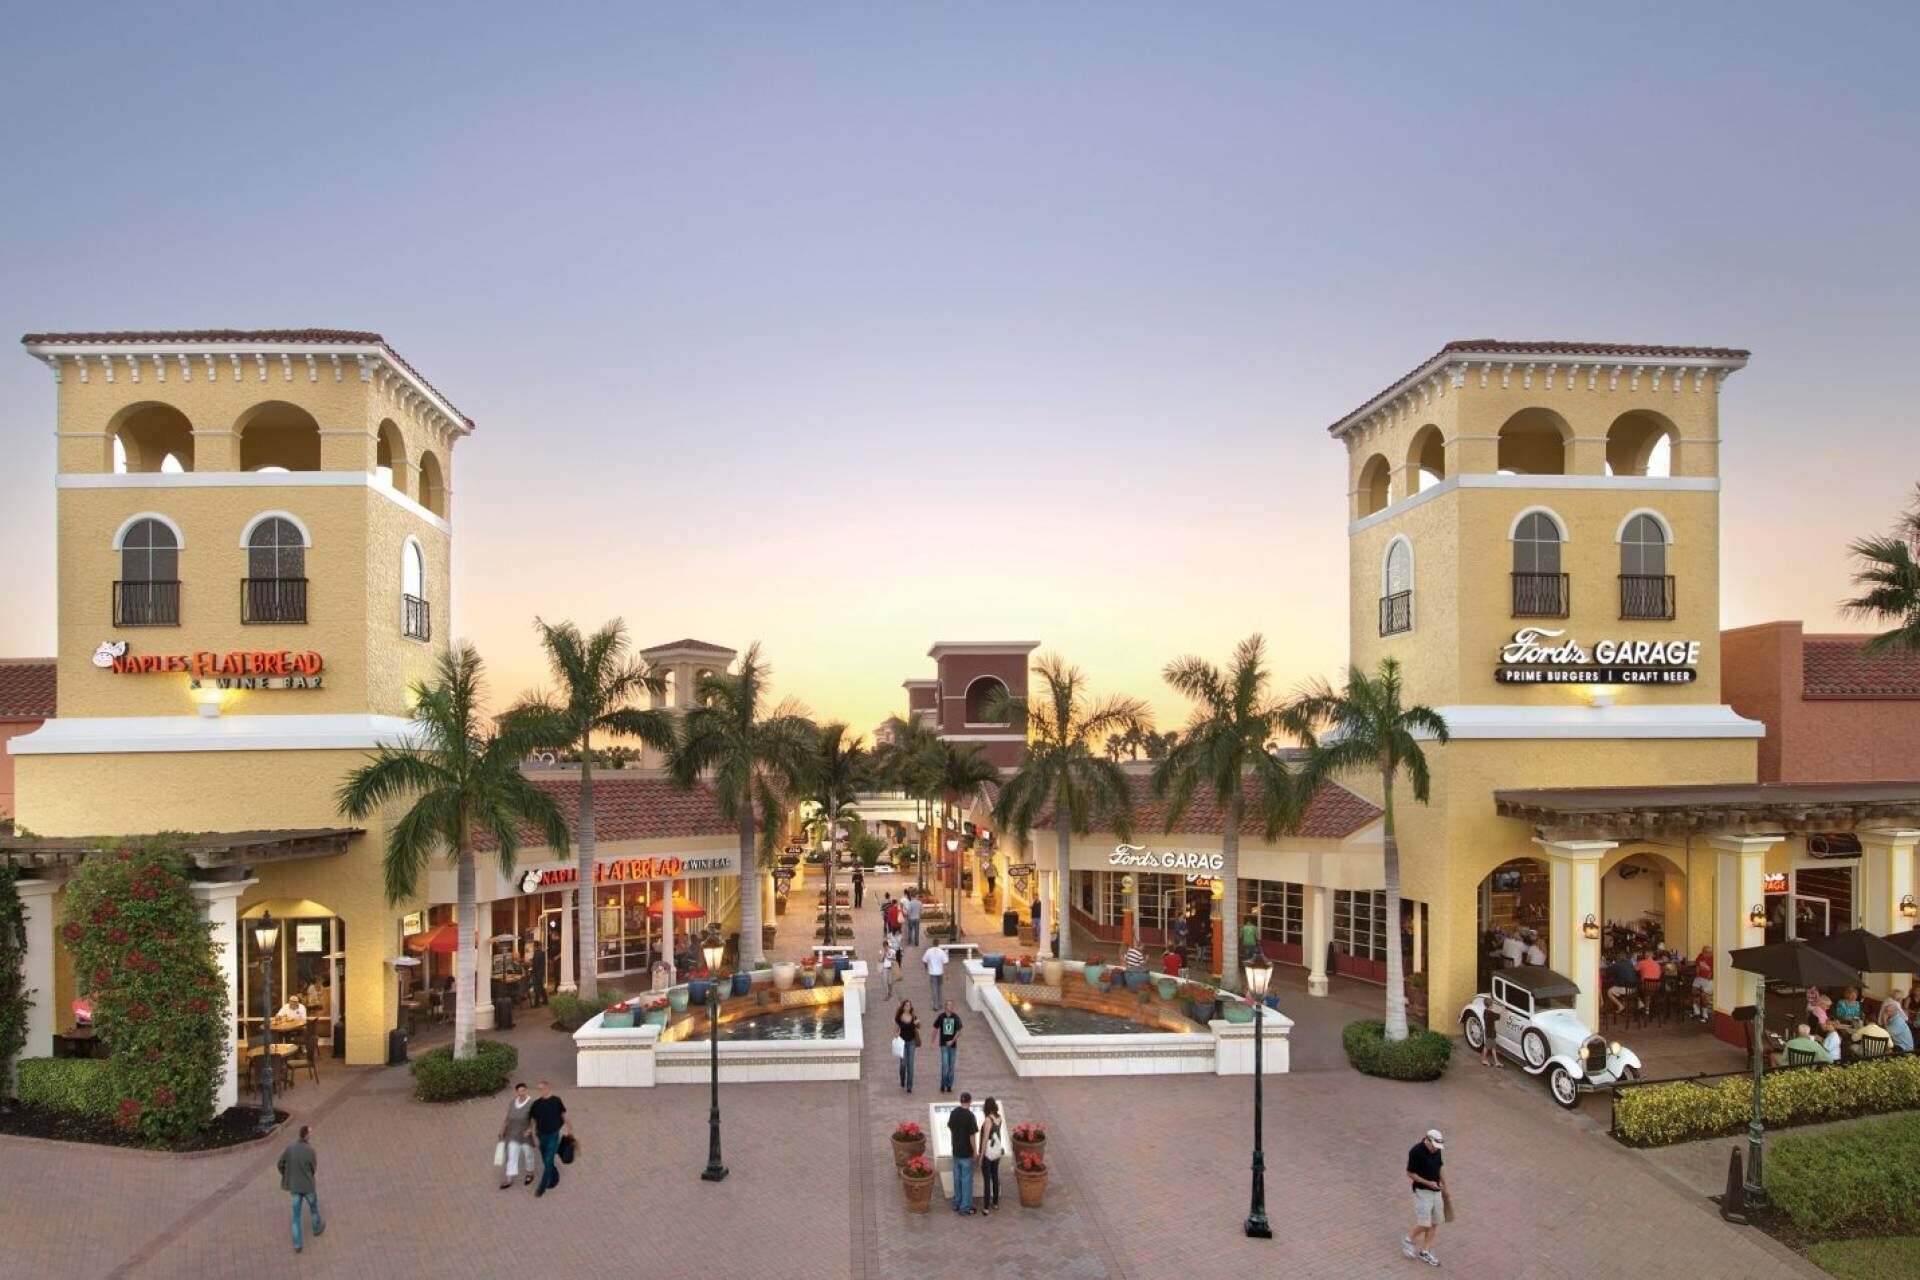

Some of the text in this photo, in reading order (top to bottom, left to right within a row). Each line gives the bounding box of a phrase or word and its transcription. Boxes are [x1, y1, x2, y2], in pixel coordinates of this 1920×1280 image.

[1502, 627, 1701, 665] Ford's GARAGE
[112, 650, 323, 676] NAPLES FLATBREAD
[216, 677, 269, 689] WINE
[283, 677, 323, 689] BAR
[1506, 671, 1690, 682] PRIME BURGERS CRAFT BEER
[1161, 852, 1224, 870] GARAG
